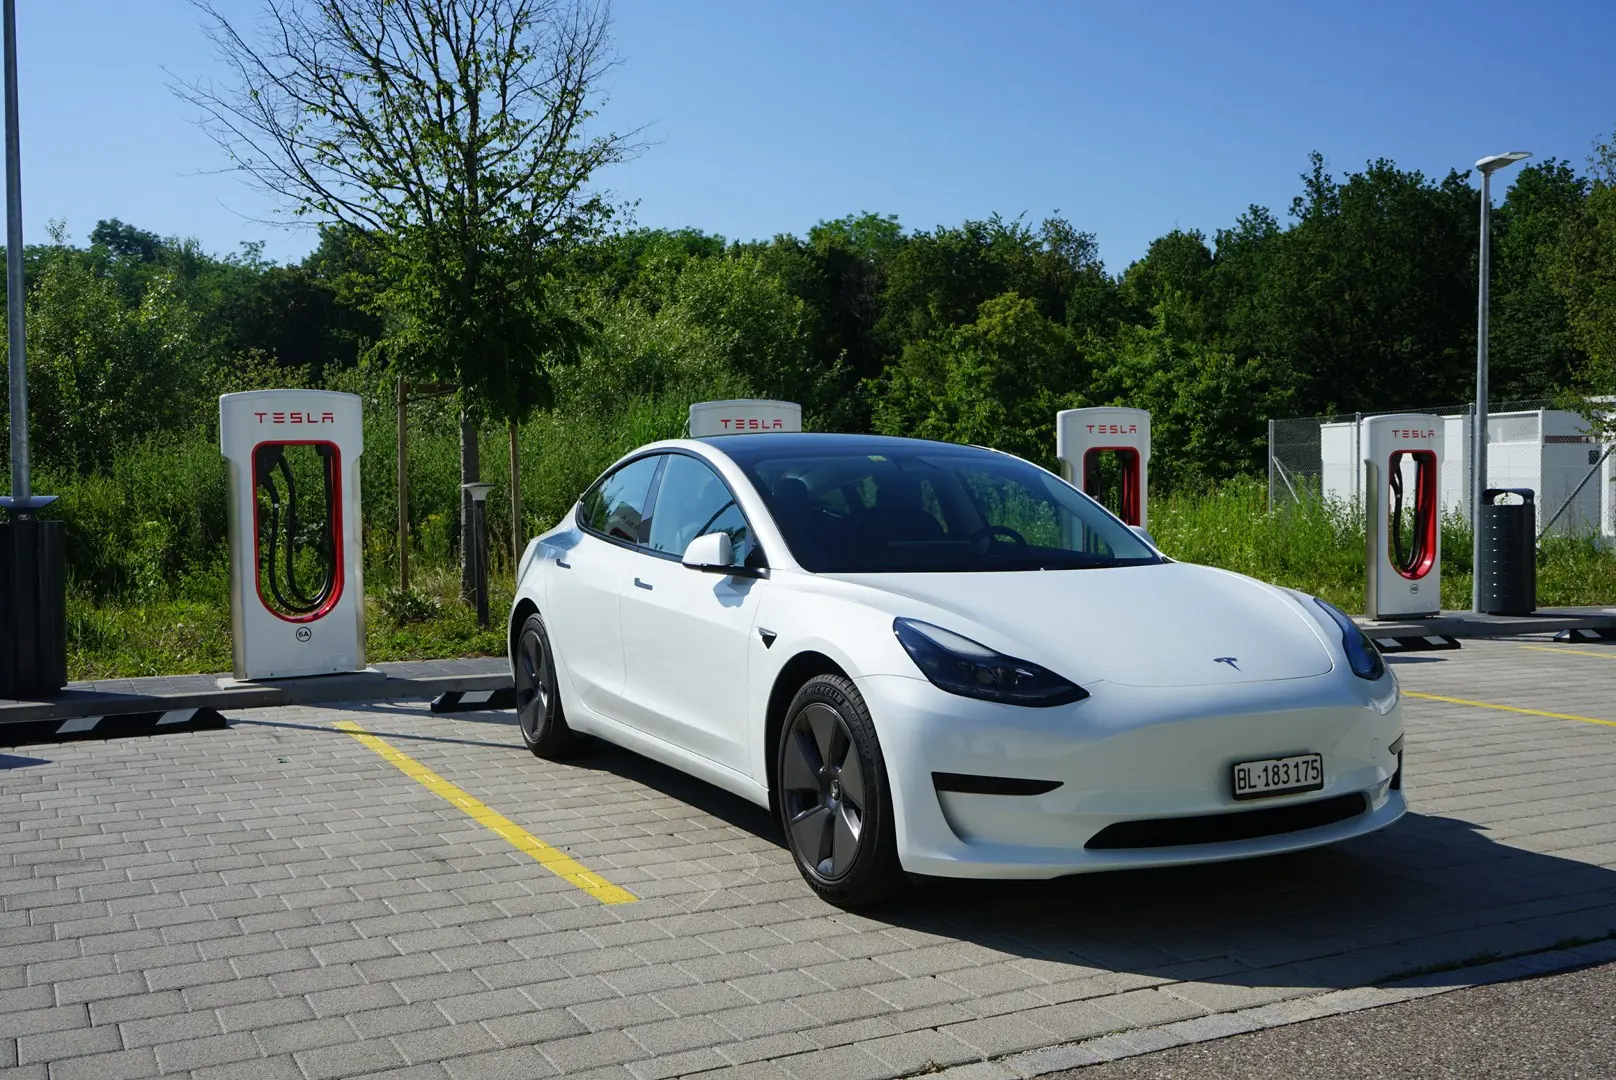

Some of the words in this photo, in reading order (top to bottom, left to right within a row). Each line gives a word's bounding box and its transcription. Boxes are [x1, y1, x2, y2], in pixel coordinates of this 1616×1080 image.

[253, 412, 335, 424] TESLA
[720, 419, 783, 429] TESLA
[1086, 424, 1137, 434] TESLA
[1391, 429, 1435, 438] TESLA
[806, 685, 844, 705] MICHELIN
